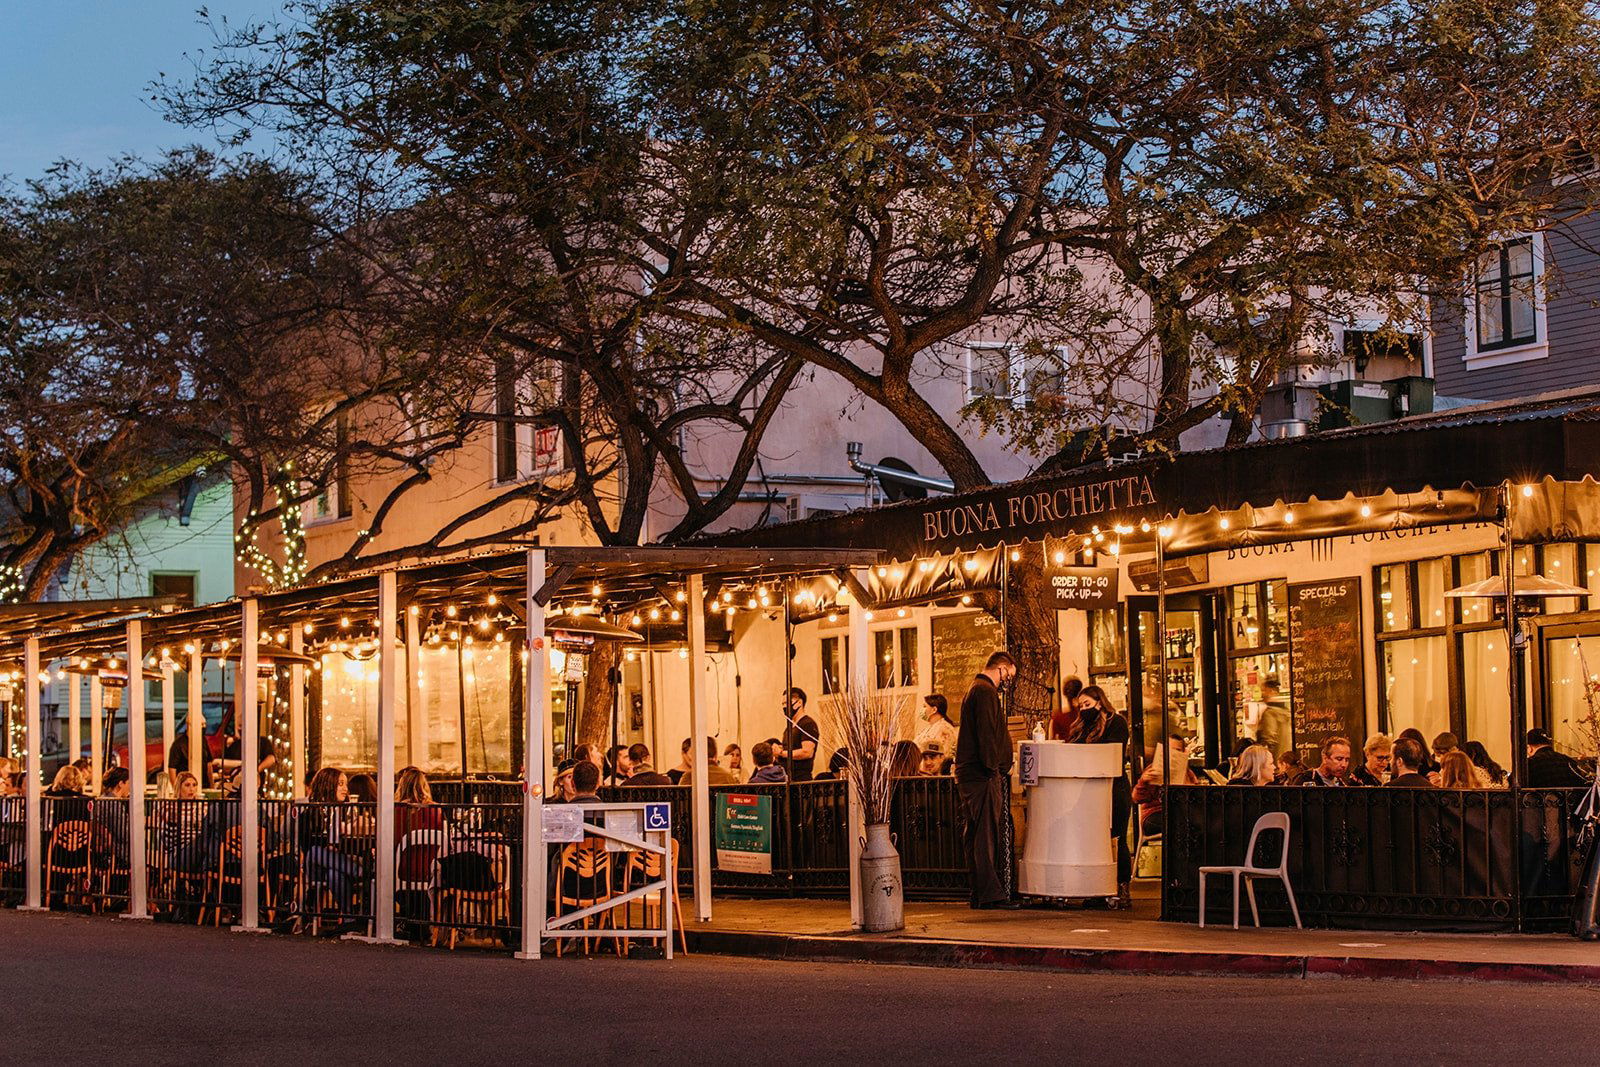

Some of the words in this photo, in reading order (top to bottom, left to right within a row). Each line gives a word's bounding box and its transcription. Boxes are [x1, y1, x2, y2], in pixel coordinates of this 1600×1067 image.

[923, 501, 1001, 541] BUONA
[1007, 475, 1157, 528] FORCHETTA
[1052, 576, 1078, 587] ORDER
[1056, 588, 1091, 599] PICK-UP
[1299, 585, 1347, 600] SPECIALS
[974, 615, 999, 627] SPEC
[1237, 621, 1245, 637] A
